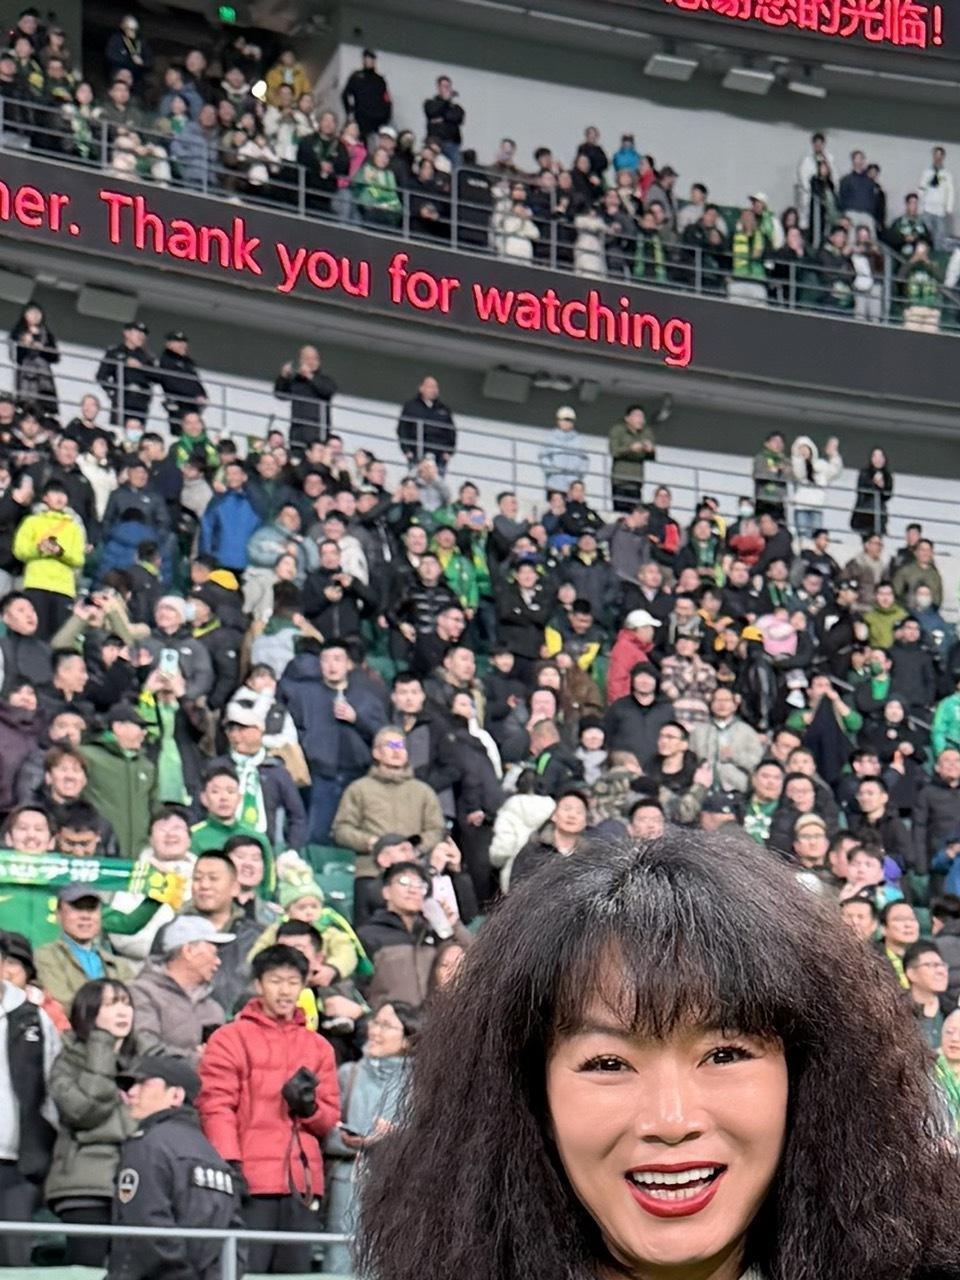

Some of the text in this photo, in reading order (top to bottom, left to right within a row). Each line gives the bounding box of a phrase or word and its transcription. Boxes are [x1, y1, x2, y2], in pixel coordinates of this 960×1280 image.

[664, 0, 944, 48] 您的光临!
[99, 188, 263, 276] Thank
[276, 242, 371, 299] you
[388, 251, 460, 314] for
[472, 280, 693, 368] watching
